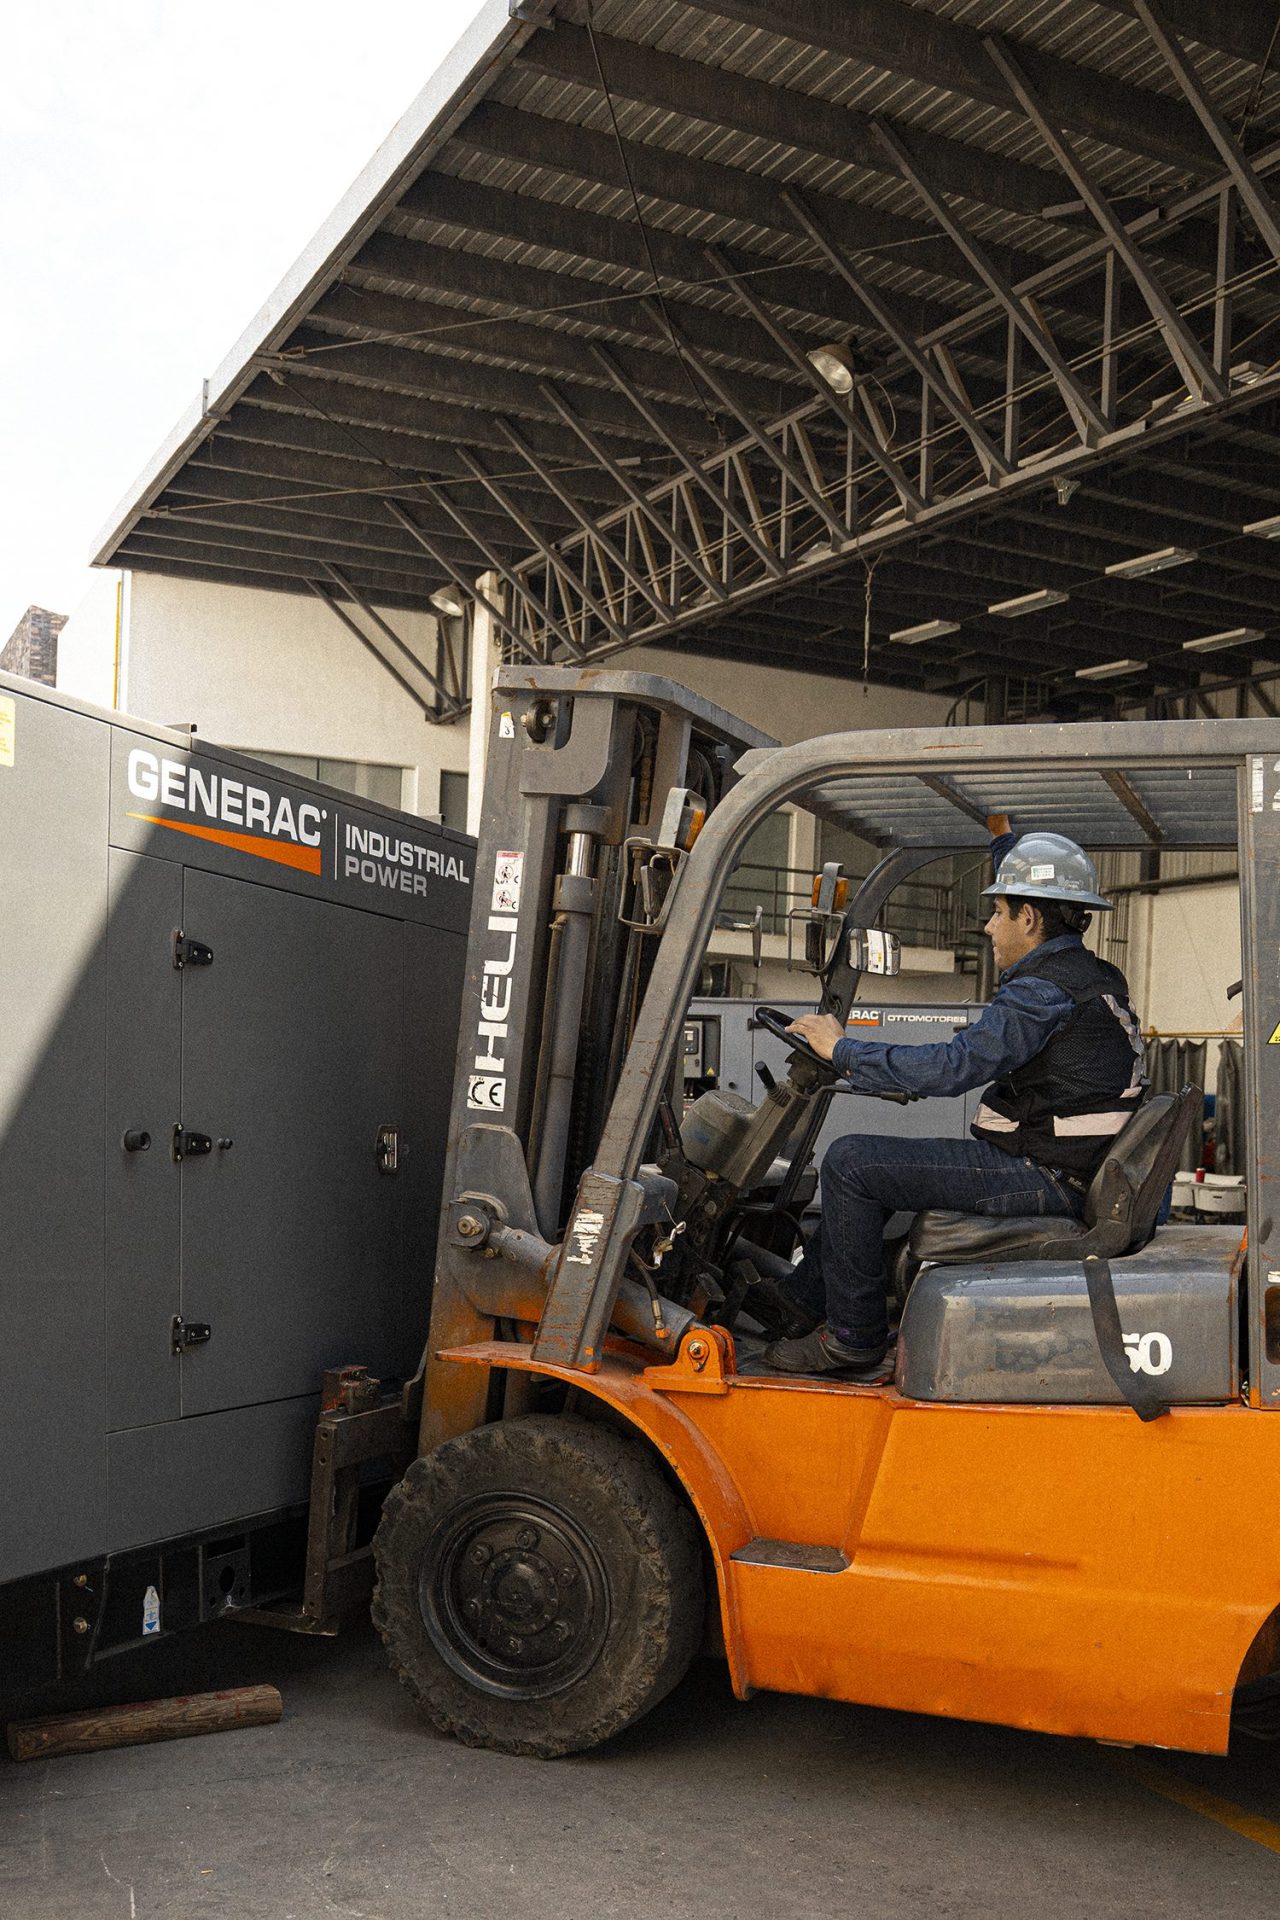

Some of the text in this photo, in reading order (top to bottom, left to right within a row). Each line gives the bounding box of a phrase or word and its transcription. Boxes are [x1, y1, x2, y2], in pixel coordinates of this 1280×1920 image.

[128, 748, 322, 846] GENERAC
[345, 824, 470, 884] INDUSTRIAL
[345, 855, 427, 897] POWER
[475, 916, 518, 1072] HELI
[887, 1014, 967, 1023] OTTOMOTORES
[472, 1081, 502, 1106] CE
